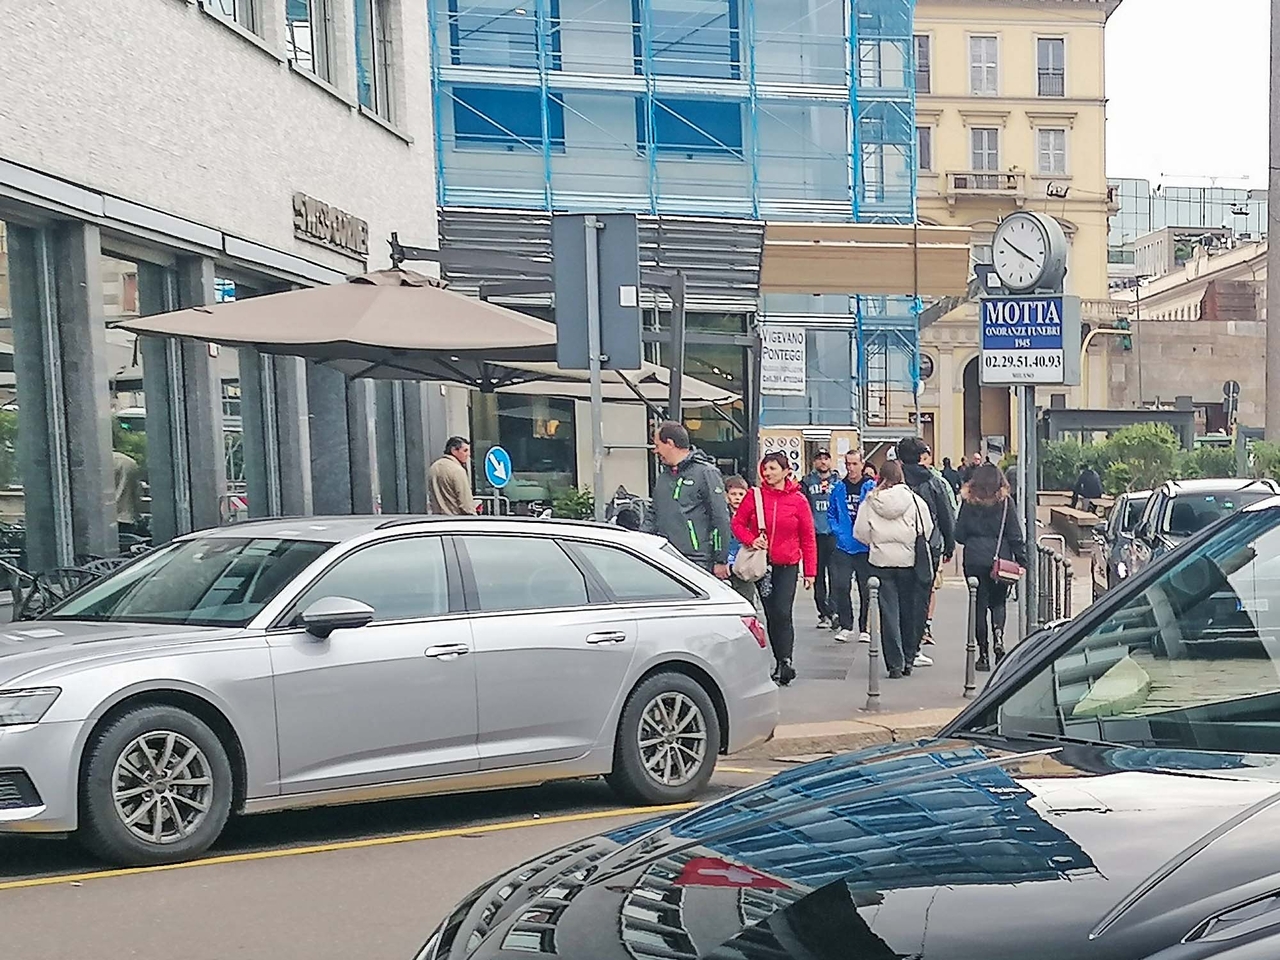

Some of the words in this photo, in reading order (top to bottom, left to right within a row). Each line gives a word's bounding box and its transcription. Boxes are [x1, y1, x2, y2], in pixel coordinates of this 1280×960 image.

[985, 300, 1061, 325] MOTTA
[762, 328, 804, 345] VIGEVANO
[985, 326, 1027, 337] ONORANZE
[1028, 326, 1060, 336] FUNEBRI
[1014, 338, 1031, 348] 1945
[763, 346, 804, 362] PONTEGGI
[985, 355, 1061, 369] 02.29.51.40.93
